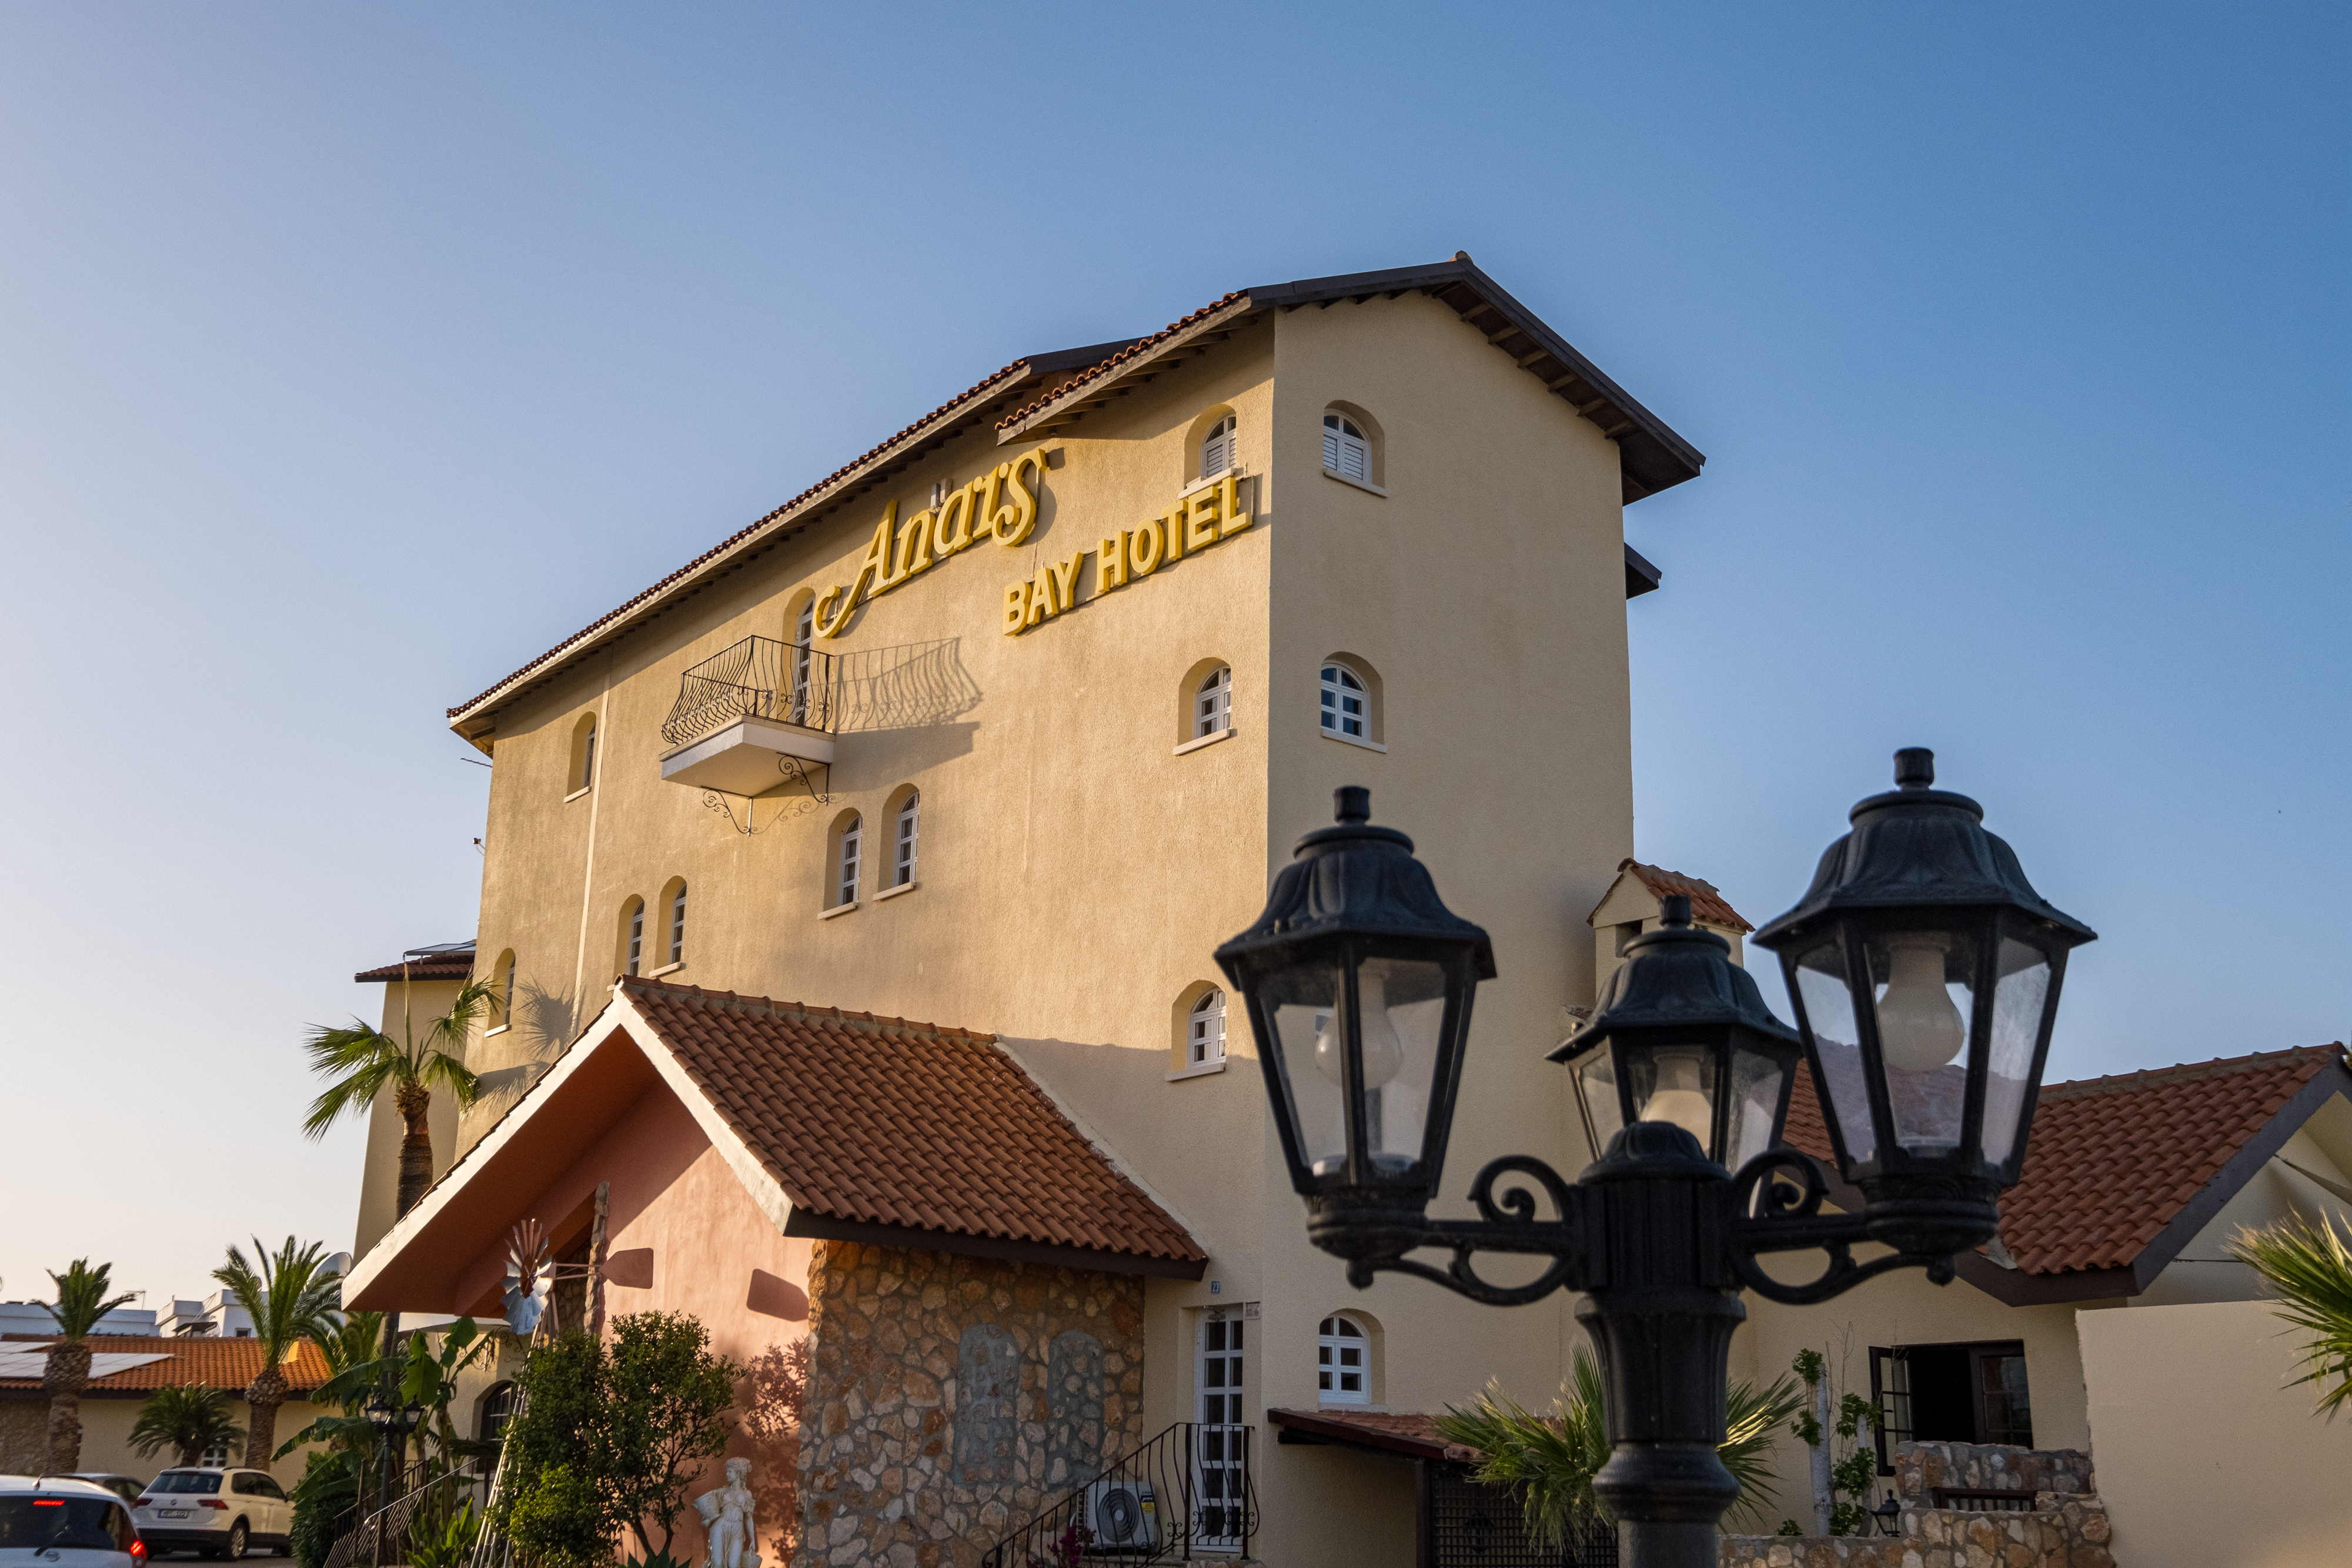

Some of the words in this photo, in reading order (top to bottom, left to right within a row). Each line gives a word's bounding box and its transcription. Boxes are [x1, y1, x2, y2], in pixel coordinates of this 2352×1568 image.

[1003, 551, 1084, 637] BAY
[1097, 477, 1252, 593] HOTEL
[1212, 1282, 1219, 1292] 23
